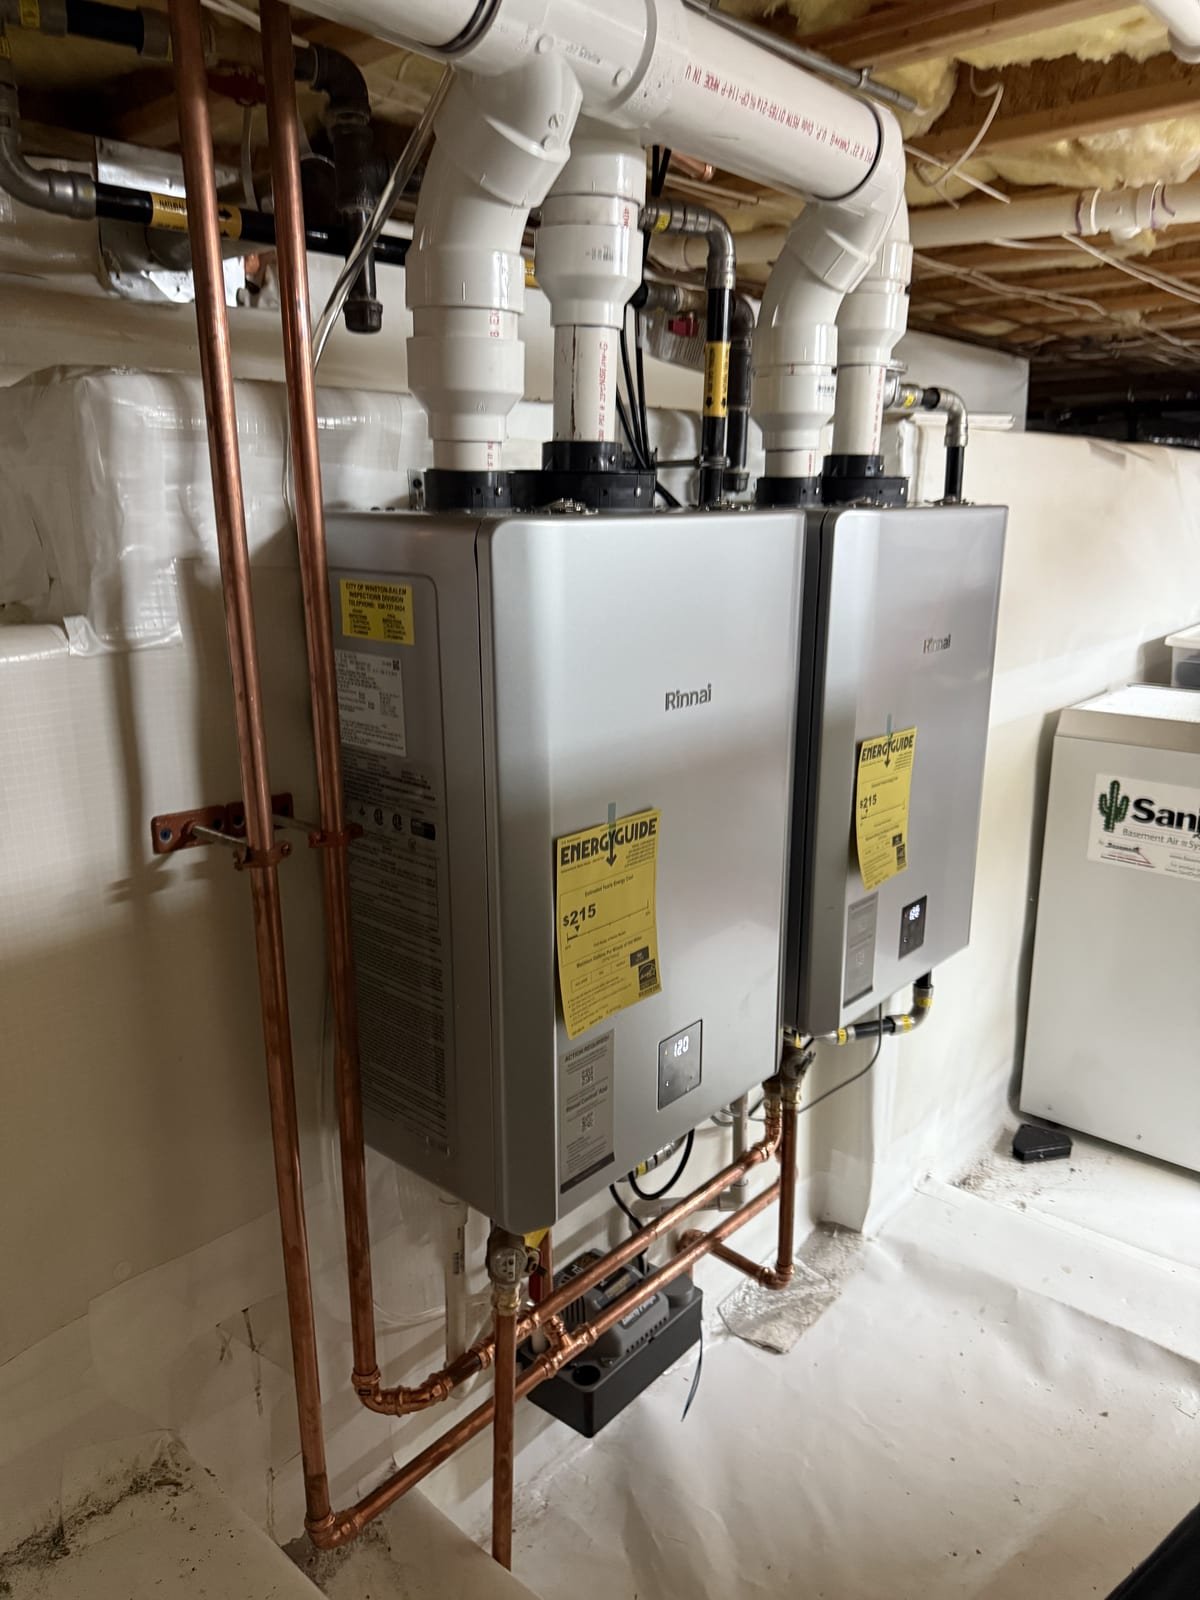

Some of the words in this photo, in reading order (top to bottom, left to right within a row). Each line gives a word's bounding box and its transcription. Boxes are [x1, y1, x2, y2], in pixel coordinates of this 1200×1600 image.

[665, 683, 712, 712] Rinnai
[861, 734, 914, 767] ENERGYGUIDE
[860, 794, 877, 809] $215
[560, 818, 658, 867] ENERGYGUIDE
[1122, 828, 1164, 844] Basement
[563, 903, 597, 927] $215
[673, 1035, 689, 1058] 120
